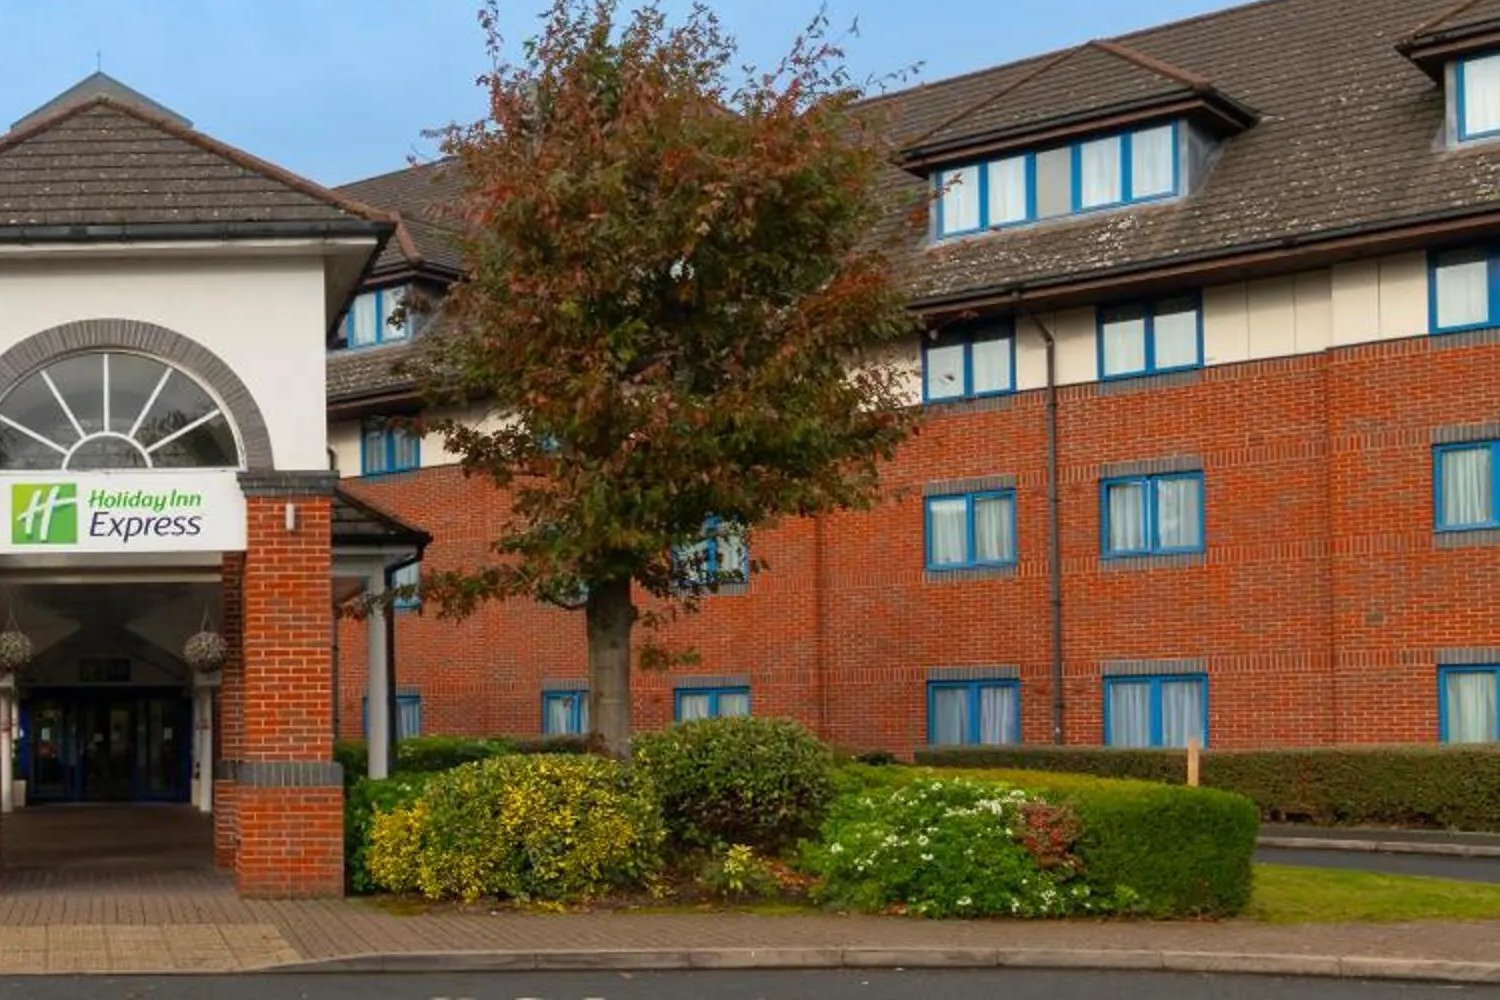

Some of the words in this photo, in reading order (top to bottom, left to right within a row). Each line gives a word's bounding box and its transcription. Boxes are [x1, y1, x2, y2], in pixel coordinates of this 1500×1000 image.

[88, 489, 167, 511] Holiday
[170, 490, 201, 507] Inn
[89, 512, 202, 542] Express
